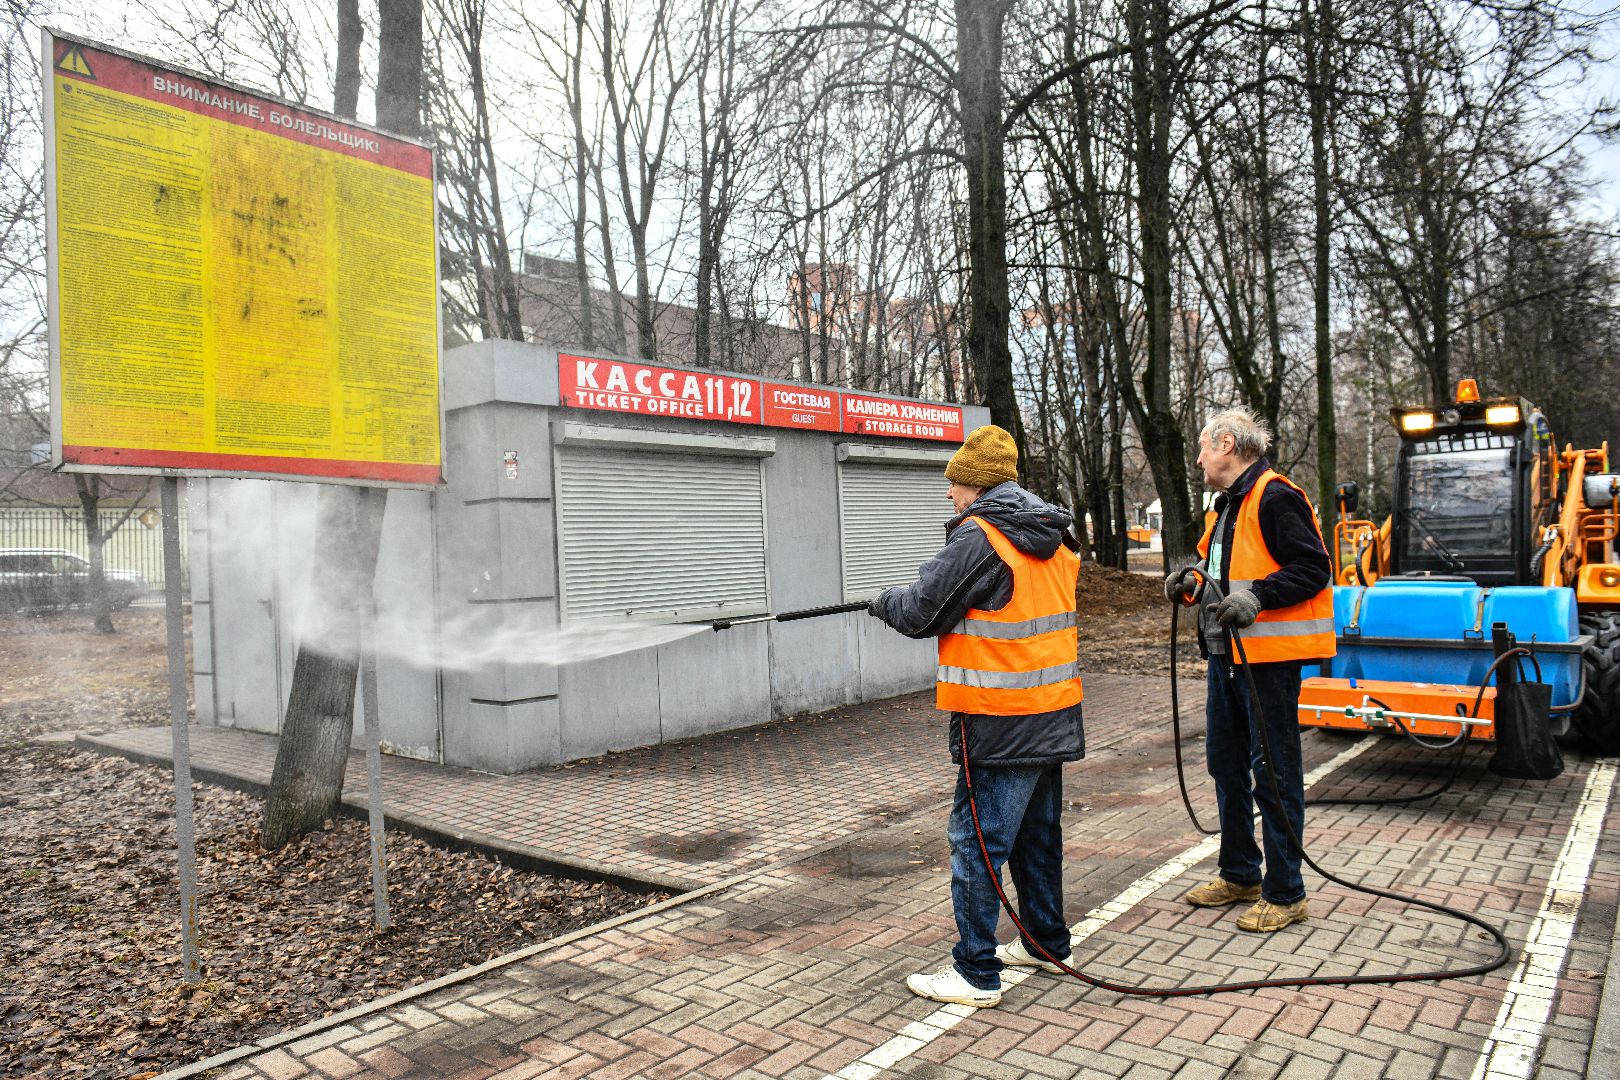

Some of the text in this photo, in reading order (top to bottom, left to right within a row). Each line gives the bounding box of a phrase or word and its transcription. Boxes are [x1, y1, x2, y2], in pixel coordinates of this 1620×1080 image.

[153, 76, 380, 154] ВНИМАНИЕ, БОЛЕЛЬЩИК!
[576, 360, 752, 420] КАССА 11,12
[773, 390, 831, 409] ГОСТЕВАЯ
[575, 391, 704, 417] TICKET OFFICE
[846, 398, 960, 424] КАМЕРА ХРАНЕНИЯ
[792, 413, 816, 424] GUEST
[865, 420, 944, 437] STORAGE ROOM
